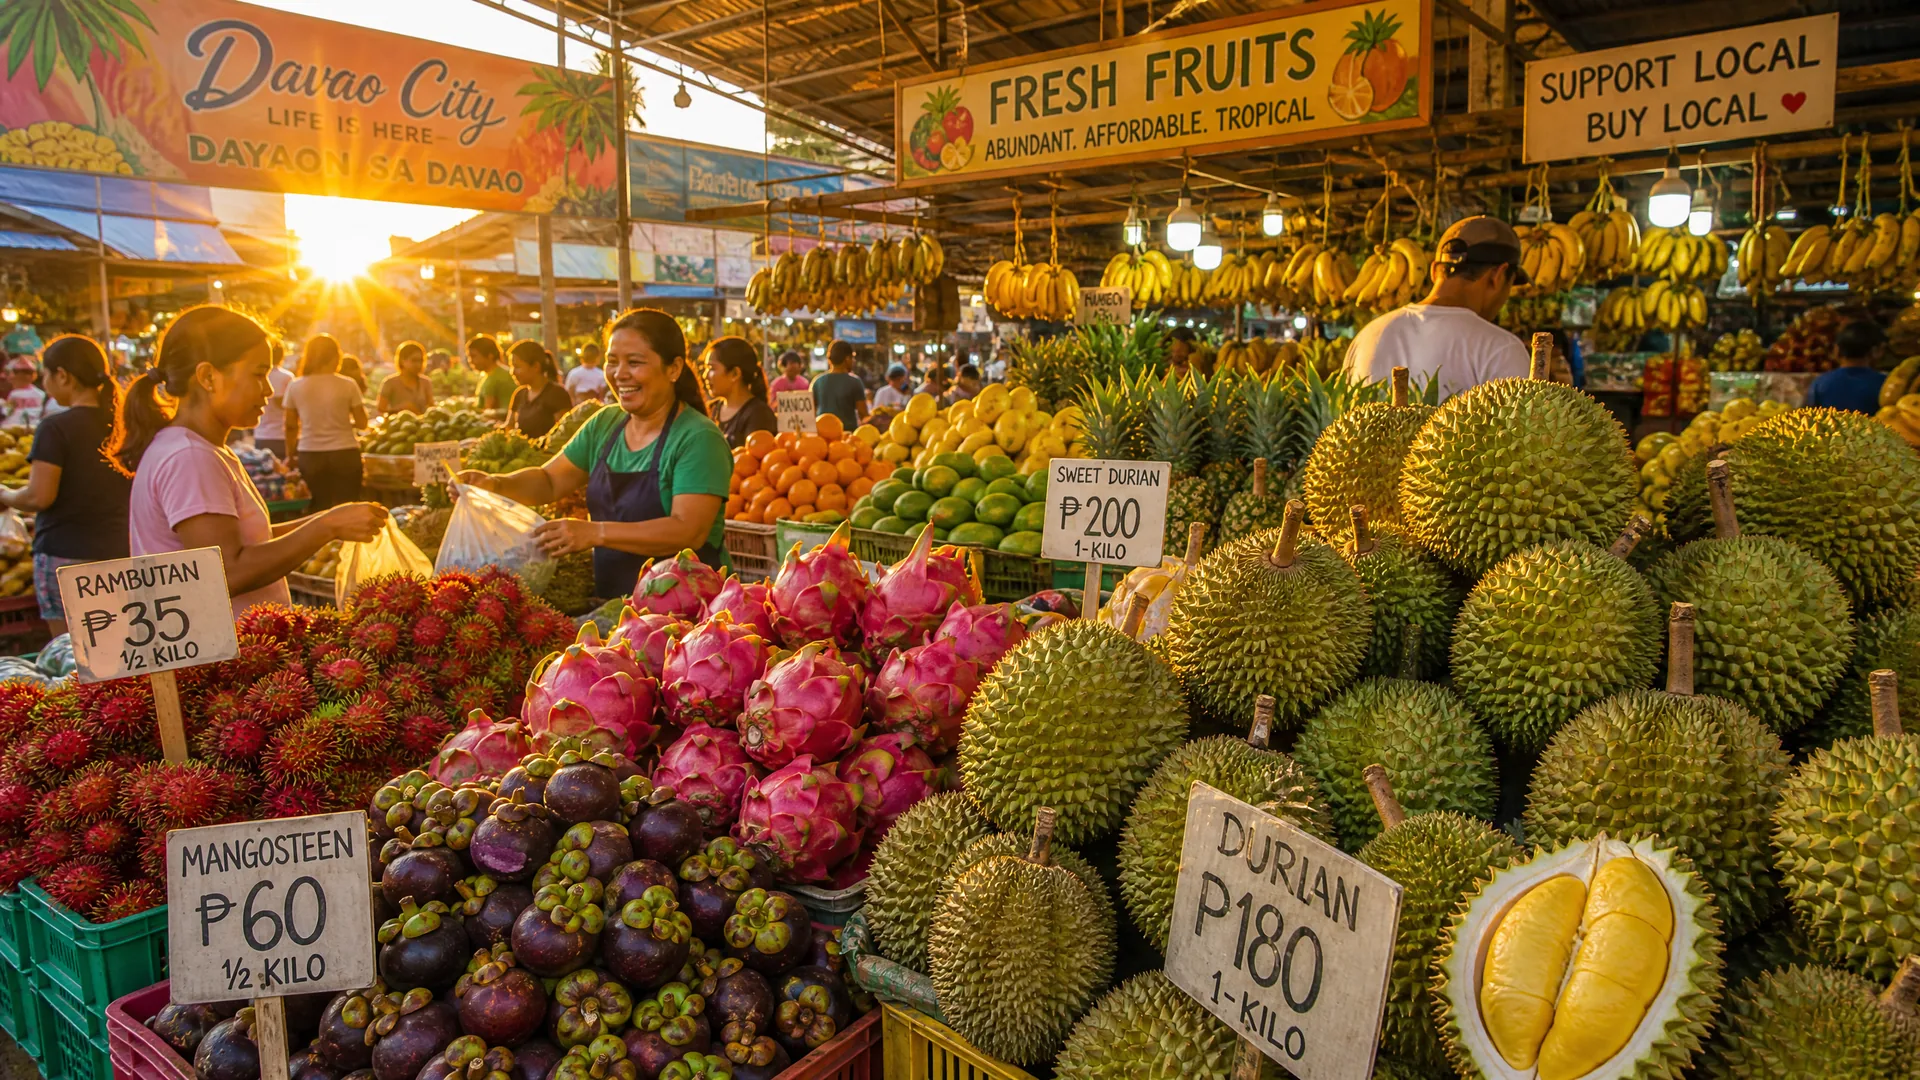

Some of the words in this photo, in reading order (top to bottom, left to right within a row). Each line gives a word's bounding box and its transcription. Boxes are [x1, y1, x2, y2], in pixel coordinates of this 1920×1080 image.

[185, 19, 387, 111] Davao
[401, 59, 506, 146] City
[990, 60, 1117, 125] FRESH
[1146, 28, 1316, 102] FRUITS
[1540, 54, 1676, 104] SUPPORT
[1694, 35, 1820, 83] LOCAL
[268, 107, 323, 131] LIFE
[338, 116, 360, 134] IS
[373, 122, 433, 145] HERE
[985, 128, 1077, 161] ABUNDANT.
[1084, 110, 1207, 148] AFFORDABLE.
[1216, 96, 1315, 131] TROPICAL
[1587, 106, 1648, 142] BUY
[1663, 92, 1768, 132] LOCAL
[188, 134, 350, 177] DAYAON
[369, 155, 414, 182] SA
[427, 160, 523, 193] DAVAO
[1056, 466, 1102, 483] SWEET
[1108, 468, 1160, 487] DURIAN
[1060, 496, 1141, 539] ₱200
[1074, 539, 1126, 560] 1-KILO
[75, 560, 200, 598] RAMBUTAN
[153, 641, 199, 665] KILO
[182, 827, 353, 877] MANGOSTEEN
[1217, 812, 1360, 932] DURIAN
[1195, 871, 1323, 1013] P180
[264, 954, 325, 986] KILO
[1210, 970, 1306, 1060] 1-KILO
